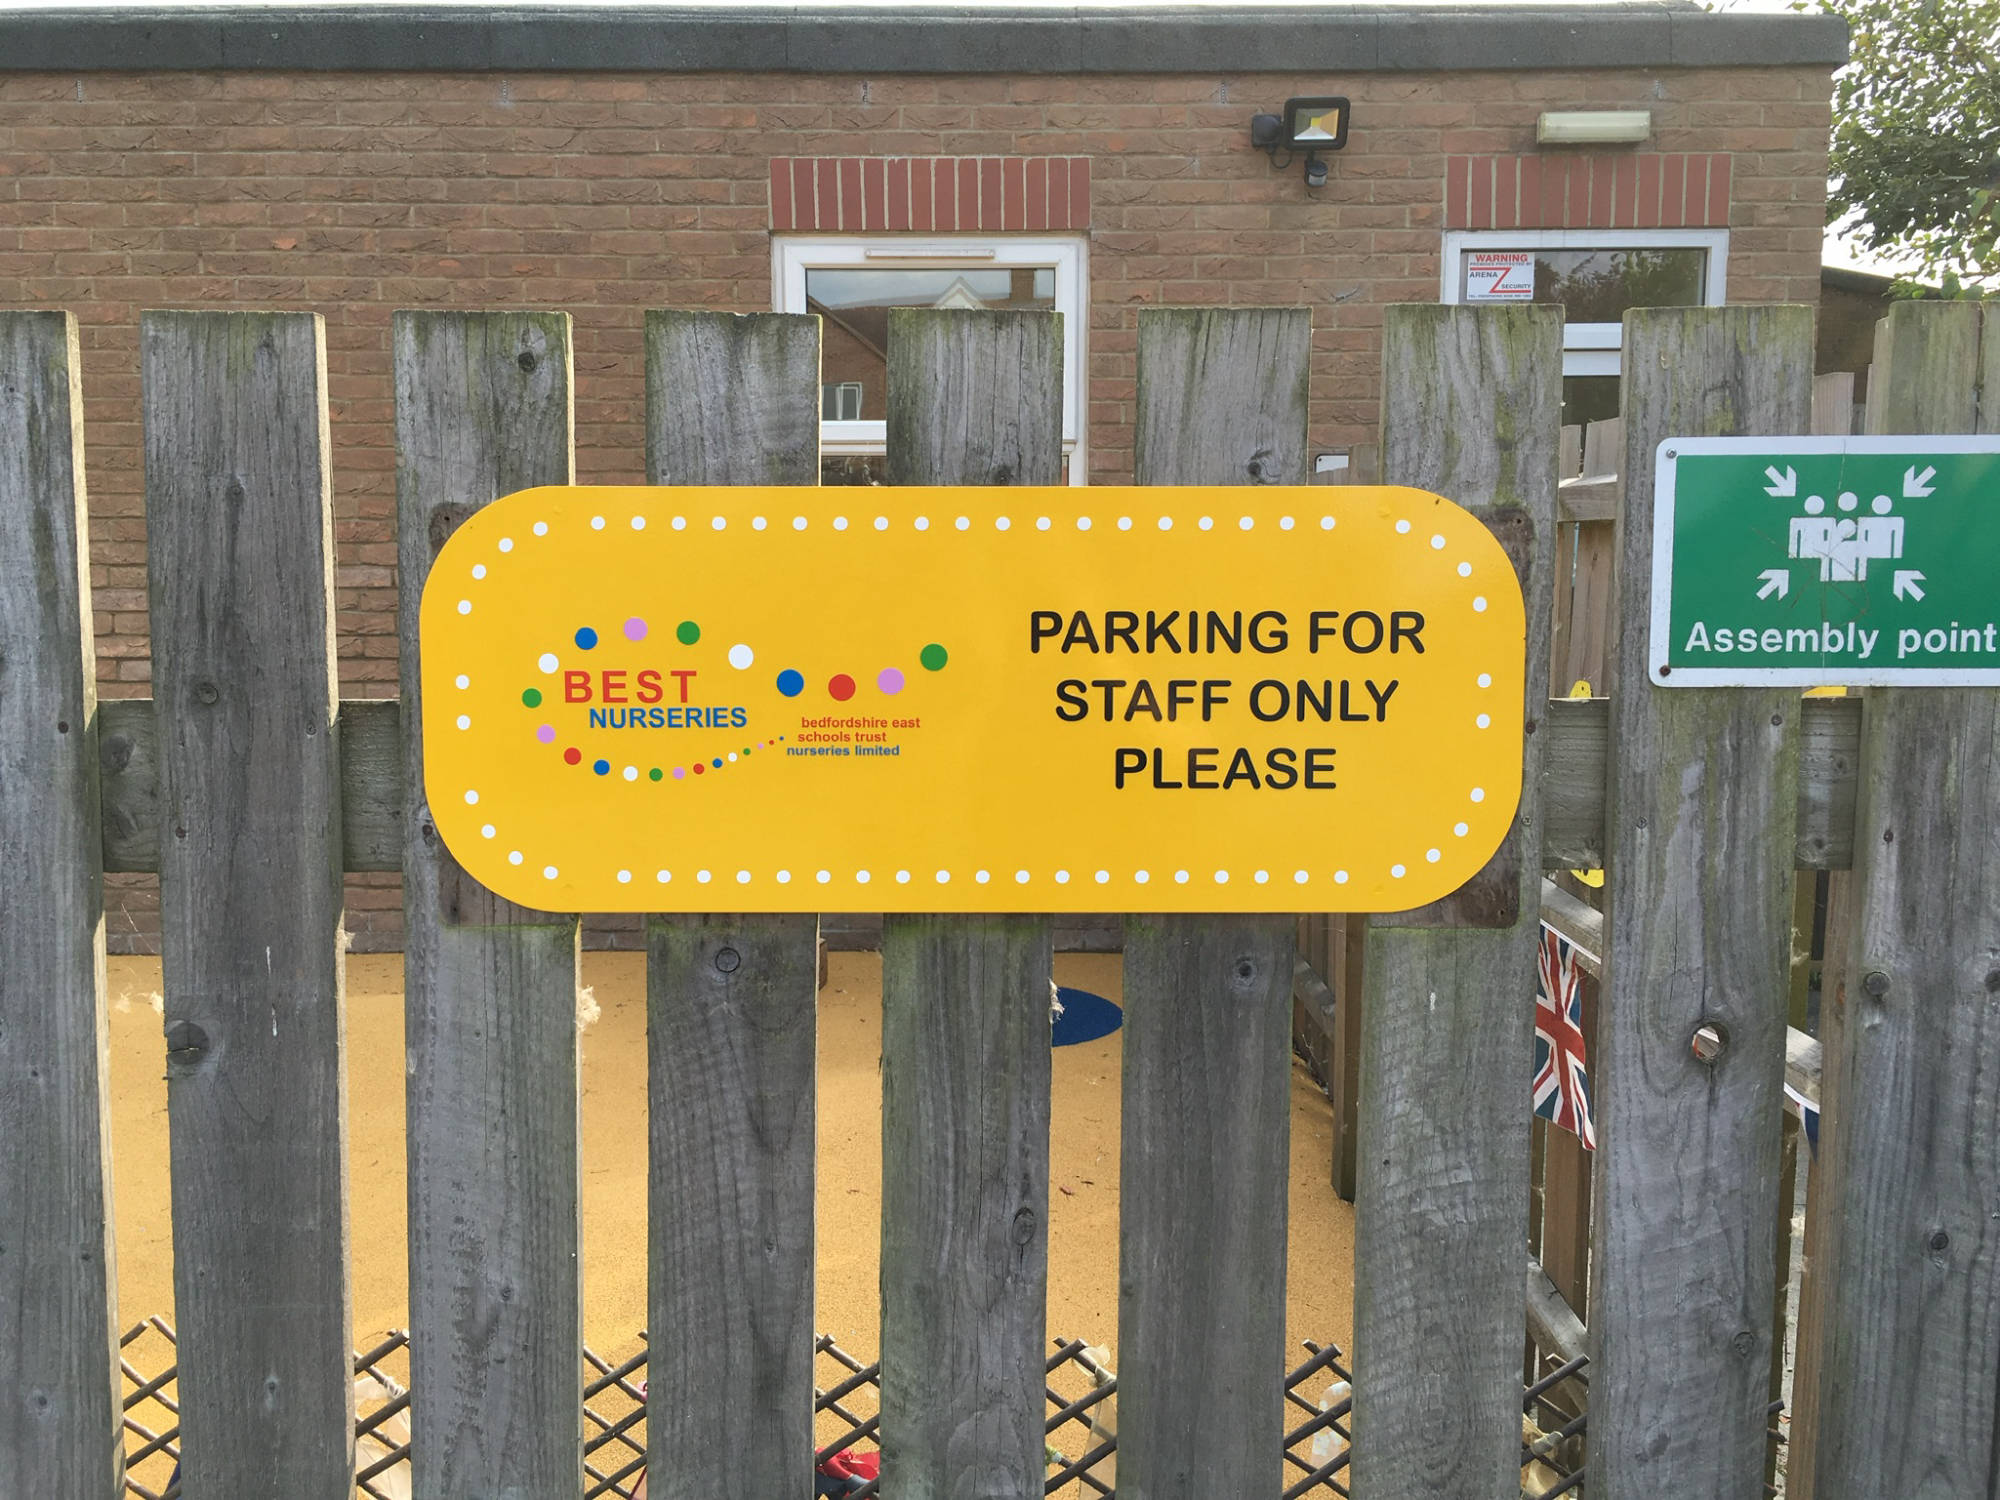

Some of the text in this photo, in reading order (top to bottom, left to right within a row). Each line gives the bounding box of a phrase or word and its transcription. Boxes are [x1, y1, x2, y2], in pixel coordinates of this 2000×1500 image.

[1475, 254, 1528, 262] WARNING
[1030, 610, 1425, 654] PARKING FOR
[1684, 621, 1998, 659] Assembly point
[563, 670, 697, 704] BEST
[1055, 679, 1399, 722] STAFF ONLY
[589, 706, 747, 729] NURSERIES
[801, 716, 921, 728] bedfordshire east
[786, 744, 900, 756] nurseries limited
[798, 731, 887, 742] schools trust
[1115, 747, 1336, 790] PLEASE
